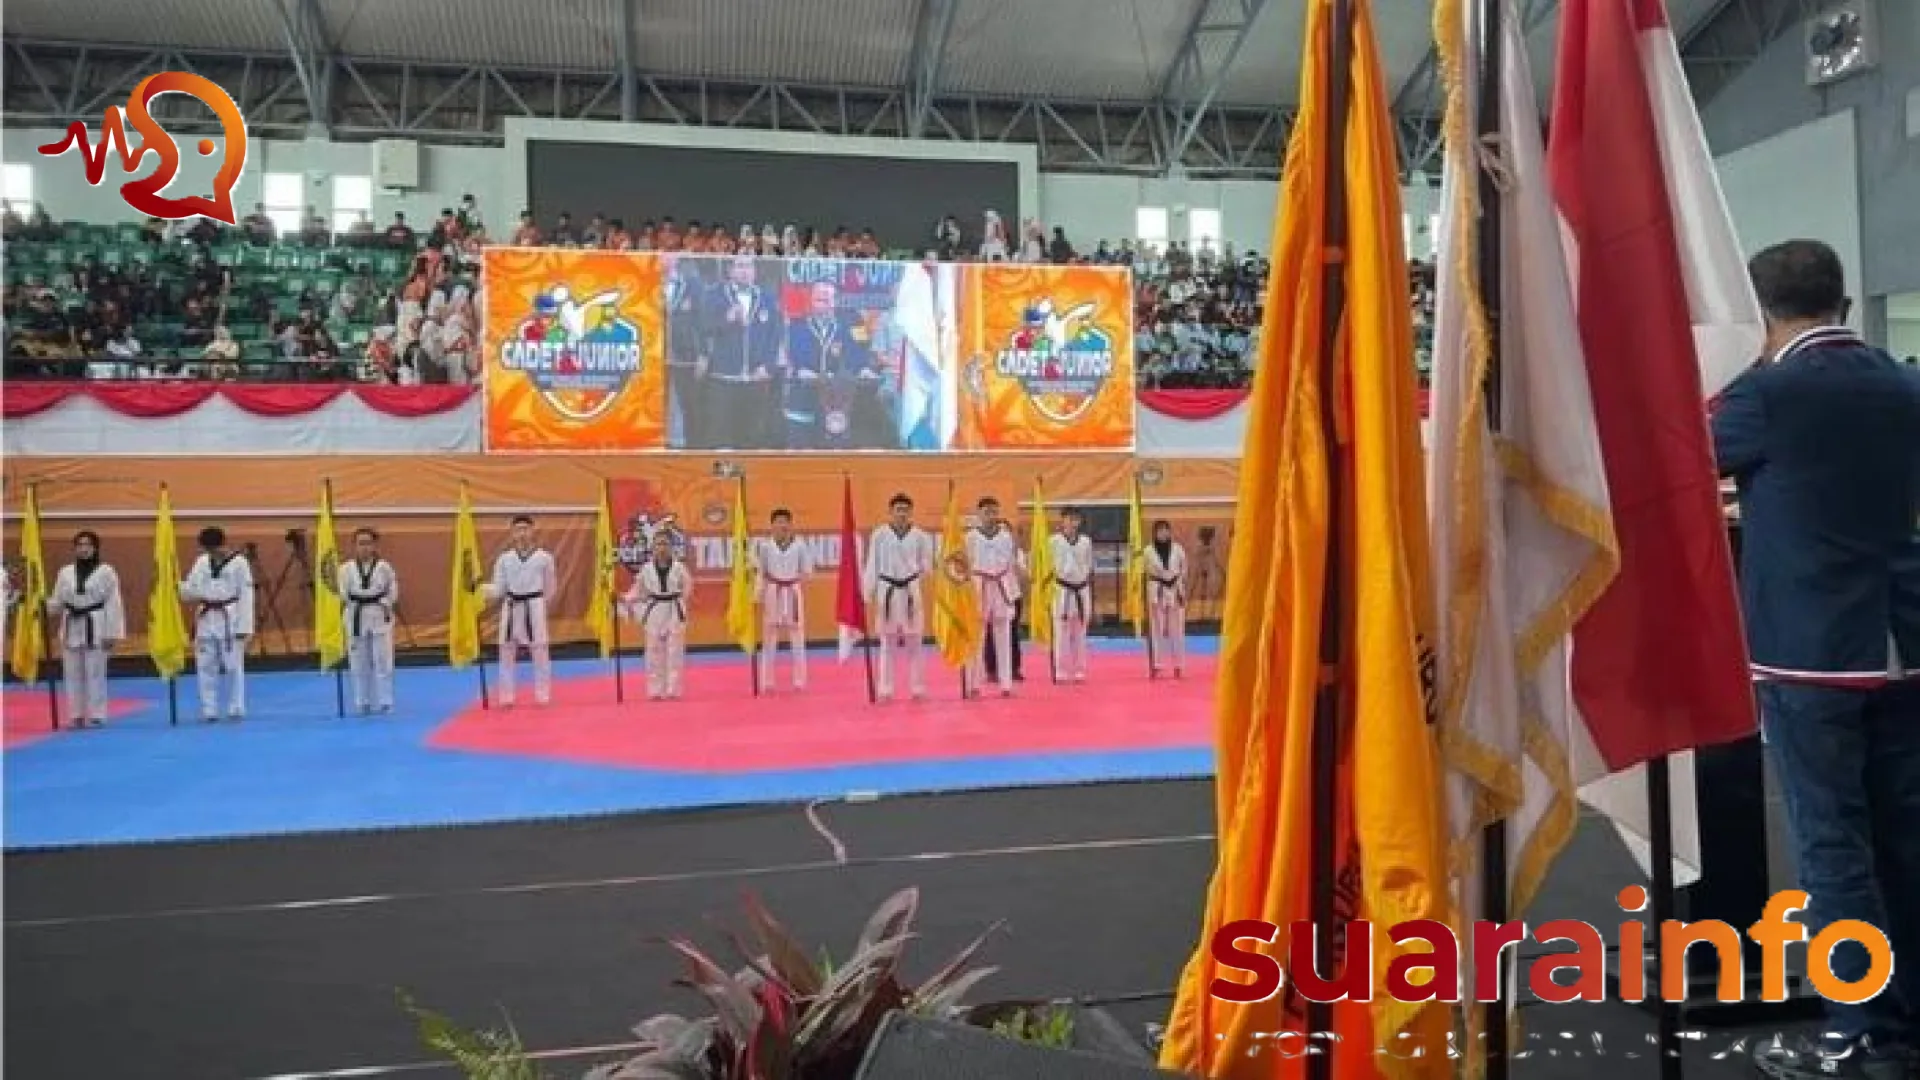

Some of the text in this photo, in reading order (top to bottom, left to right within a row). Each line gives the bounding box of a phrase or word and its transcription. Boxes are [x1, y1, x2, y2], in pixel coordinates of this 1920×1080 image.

[501, 341, 641, 371] CADET JUNIOR
[997, 350, 1113, 378] CADET JUNIOR
